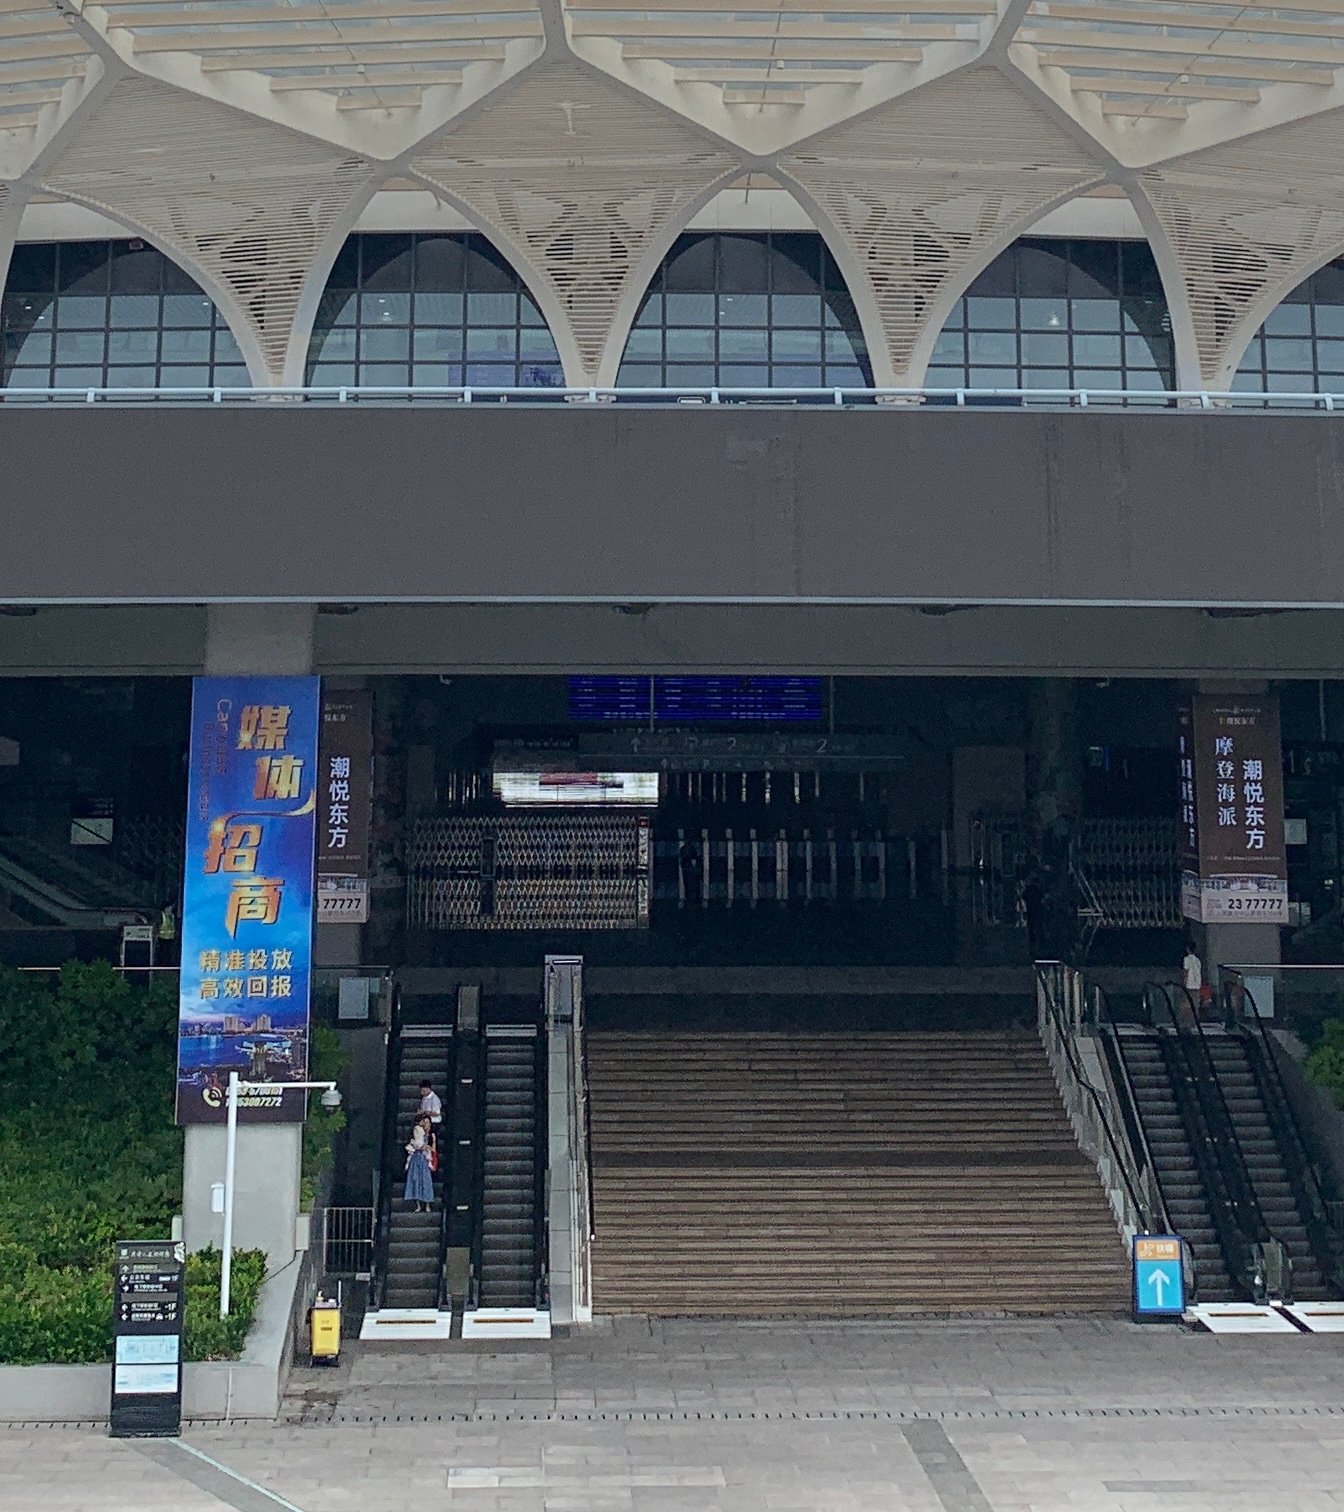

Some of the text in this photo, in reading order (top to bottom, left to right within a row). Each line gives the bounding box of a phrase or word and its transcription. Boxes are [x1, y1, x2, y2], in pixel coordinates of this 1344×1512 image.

[328, 756, 351, 849] 潮悦东方
[1215, 737, 1237, 826] 摩登海派
[1243, 760, 1266, 850] 潮悦东方
[199, 949, 292, 972] 精准投放
[199, 975, 291, 999] 高效回报
